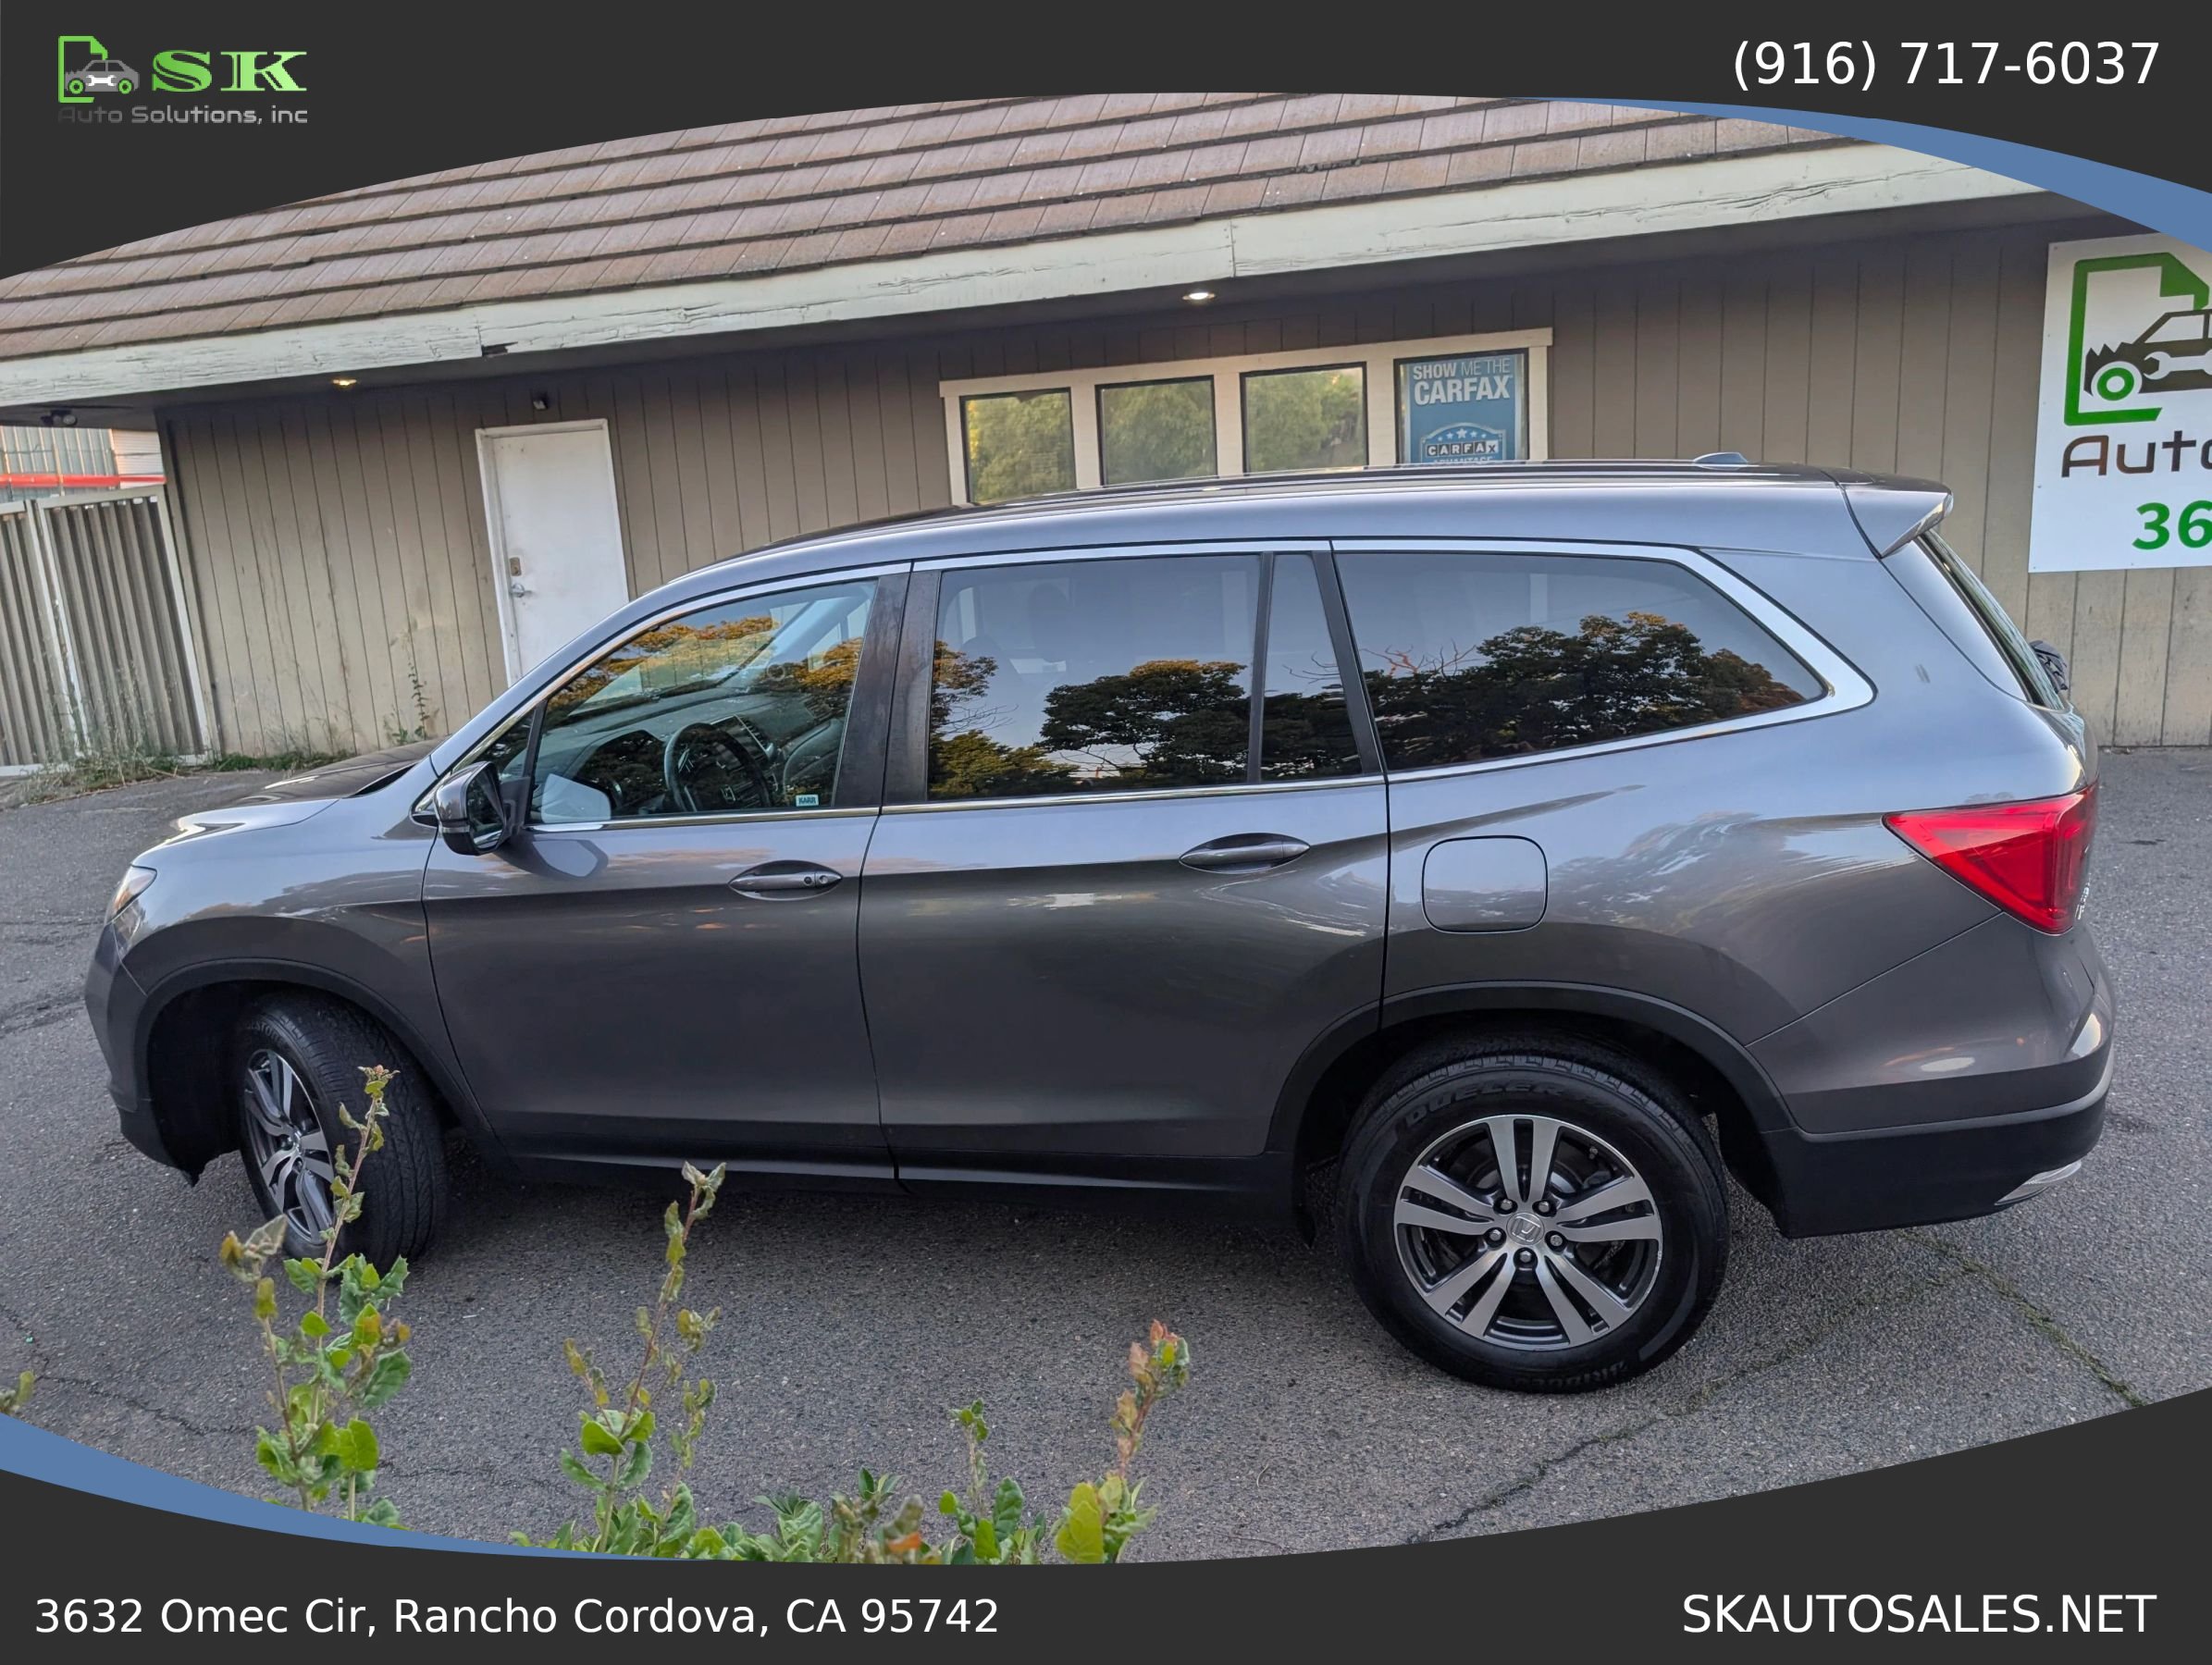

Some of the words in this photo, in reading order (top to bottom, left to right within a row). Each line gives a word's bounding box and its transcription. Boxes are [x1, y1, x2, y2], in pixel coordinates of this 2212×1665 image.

[1413, 362, 1457, 380] SHOW
[1461, 360, 1481, 376] ME
[1484, 357, 1511, 375] THE
[1414, 375, 1511, 405] CARFAX
[1427, 442, 1497, 457] CARFAX
[2132, 500, 2212, 550] 36
